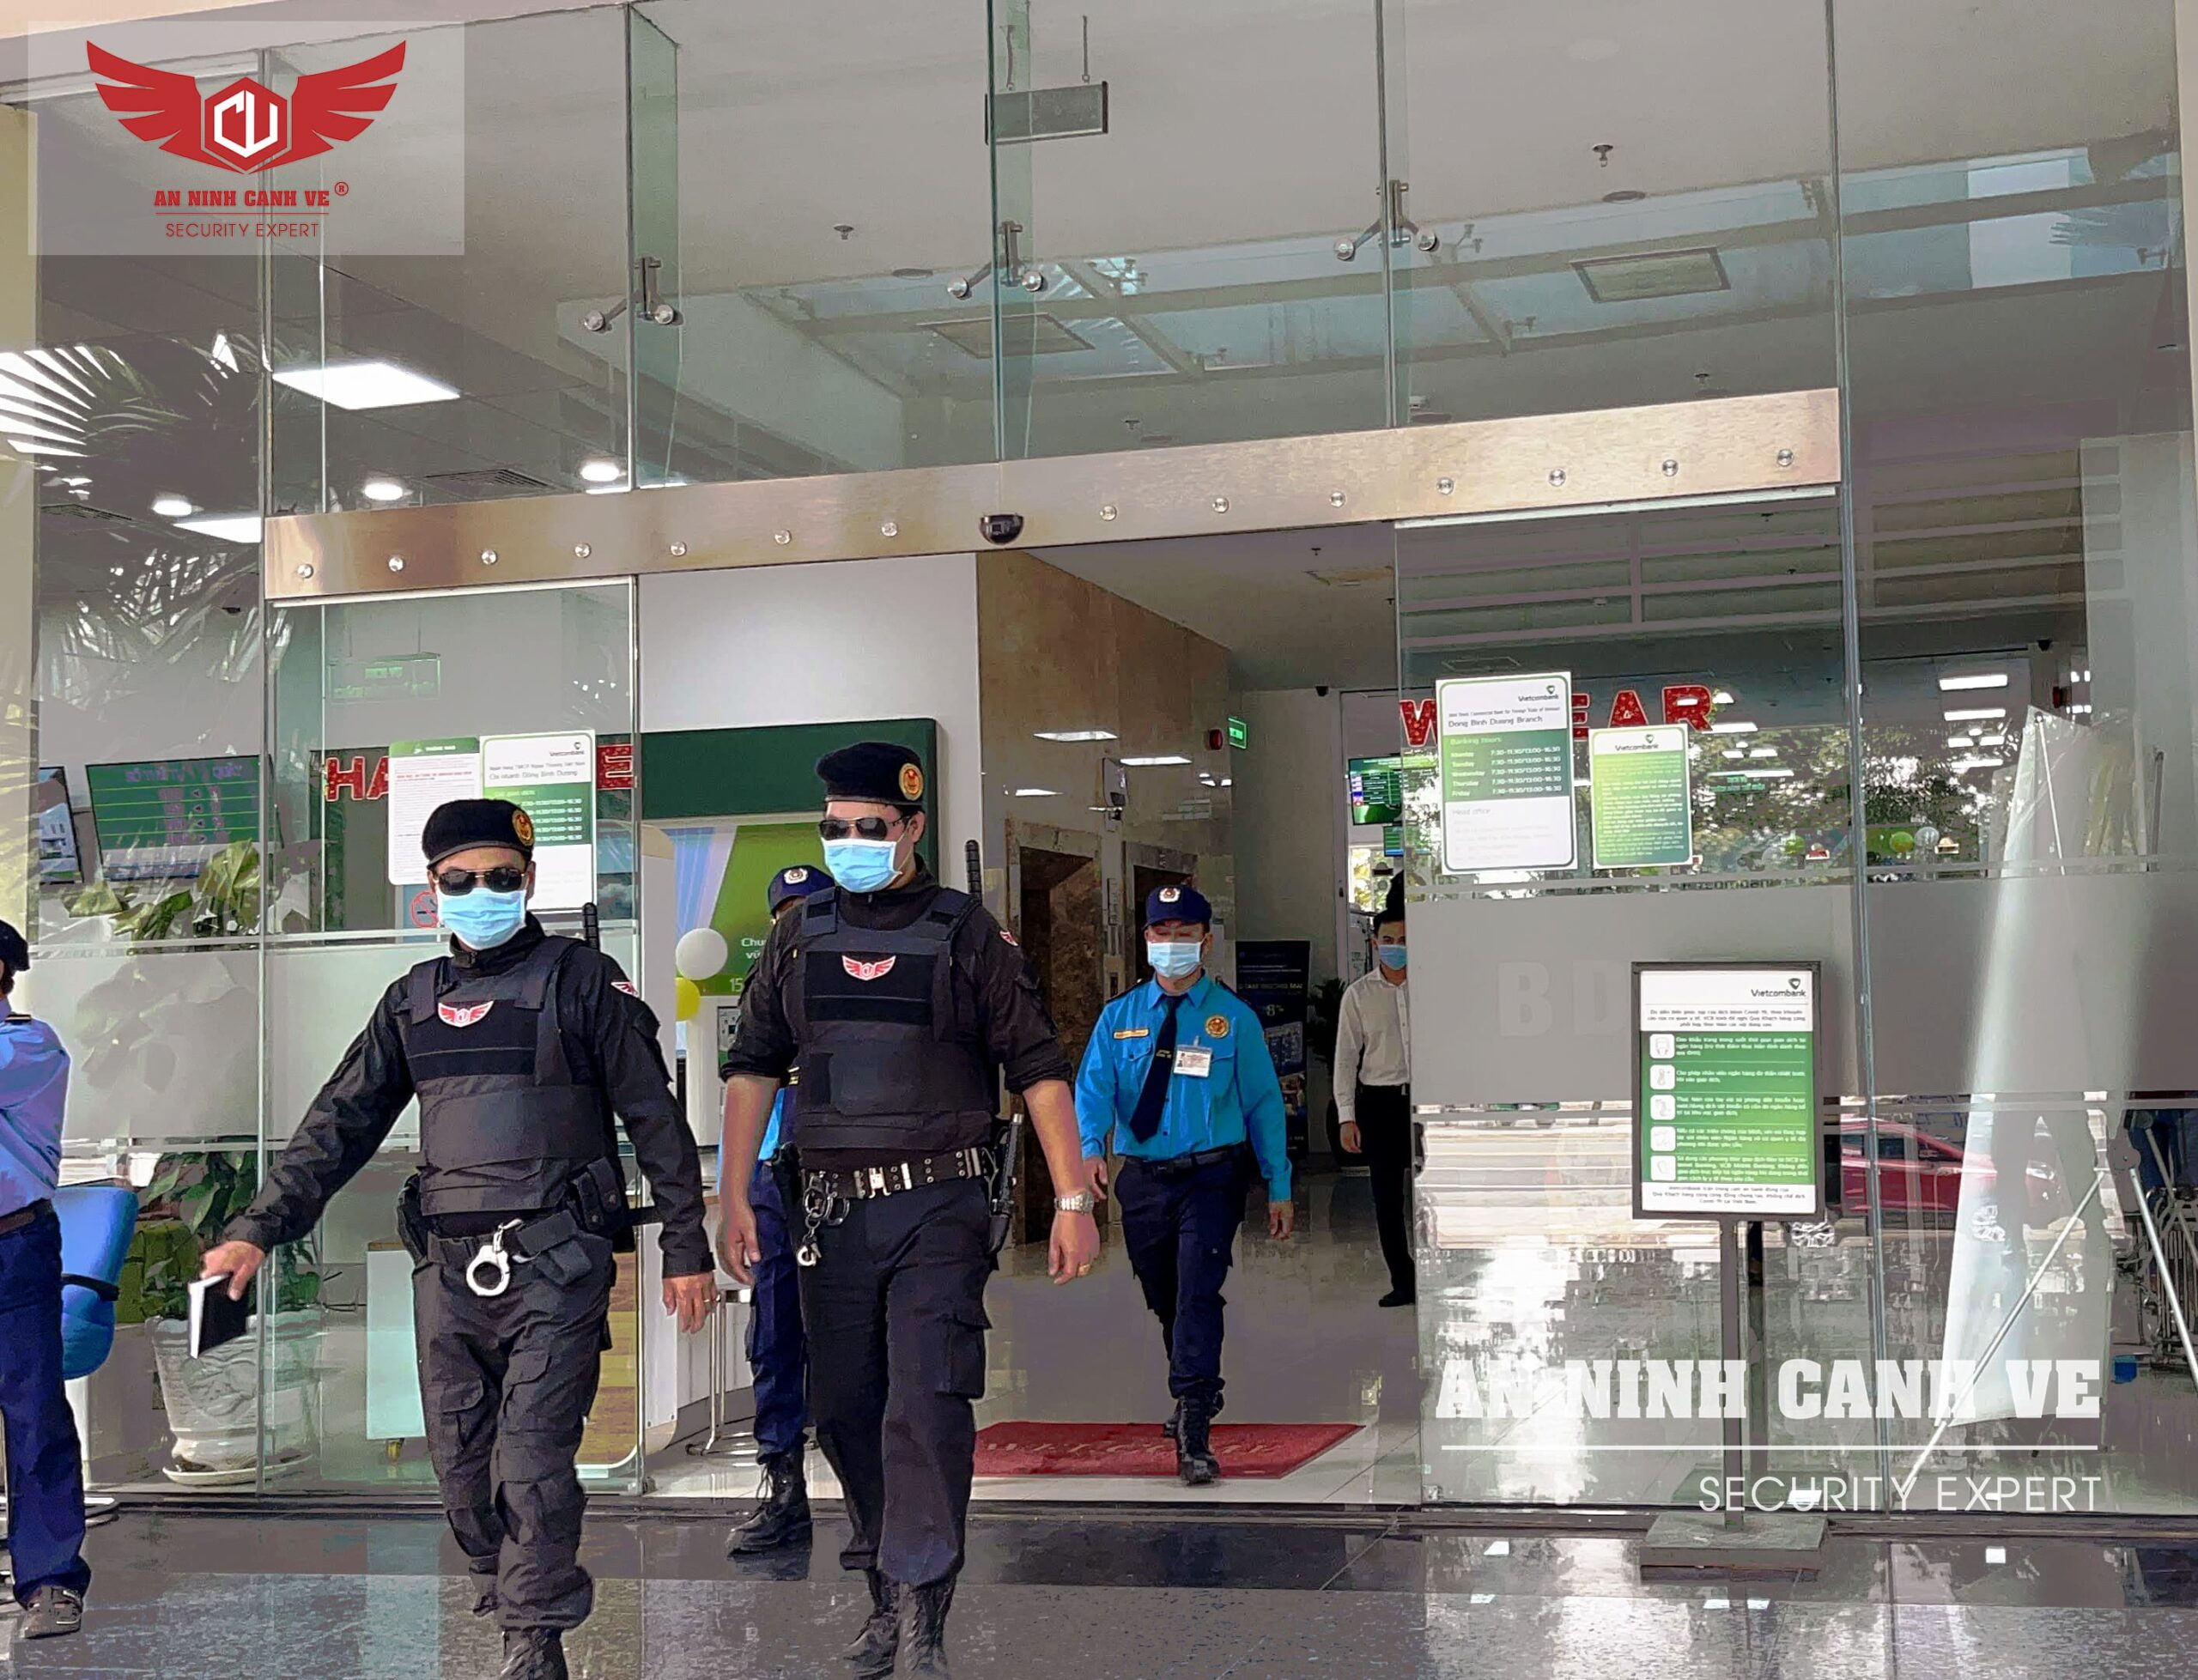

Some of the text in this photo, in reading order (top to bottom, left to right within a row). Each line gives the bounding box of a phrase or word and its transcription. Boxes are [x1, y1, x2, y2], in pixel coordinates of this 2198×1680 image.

[1517, 694, 1560, 702] Vietcombank
[1517, 715, 1543, 724] Branch
[1751, 989, 1806, 998] Vietcombank
